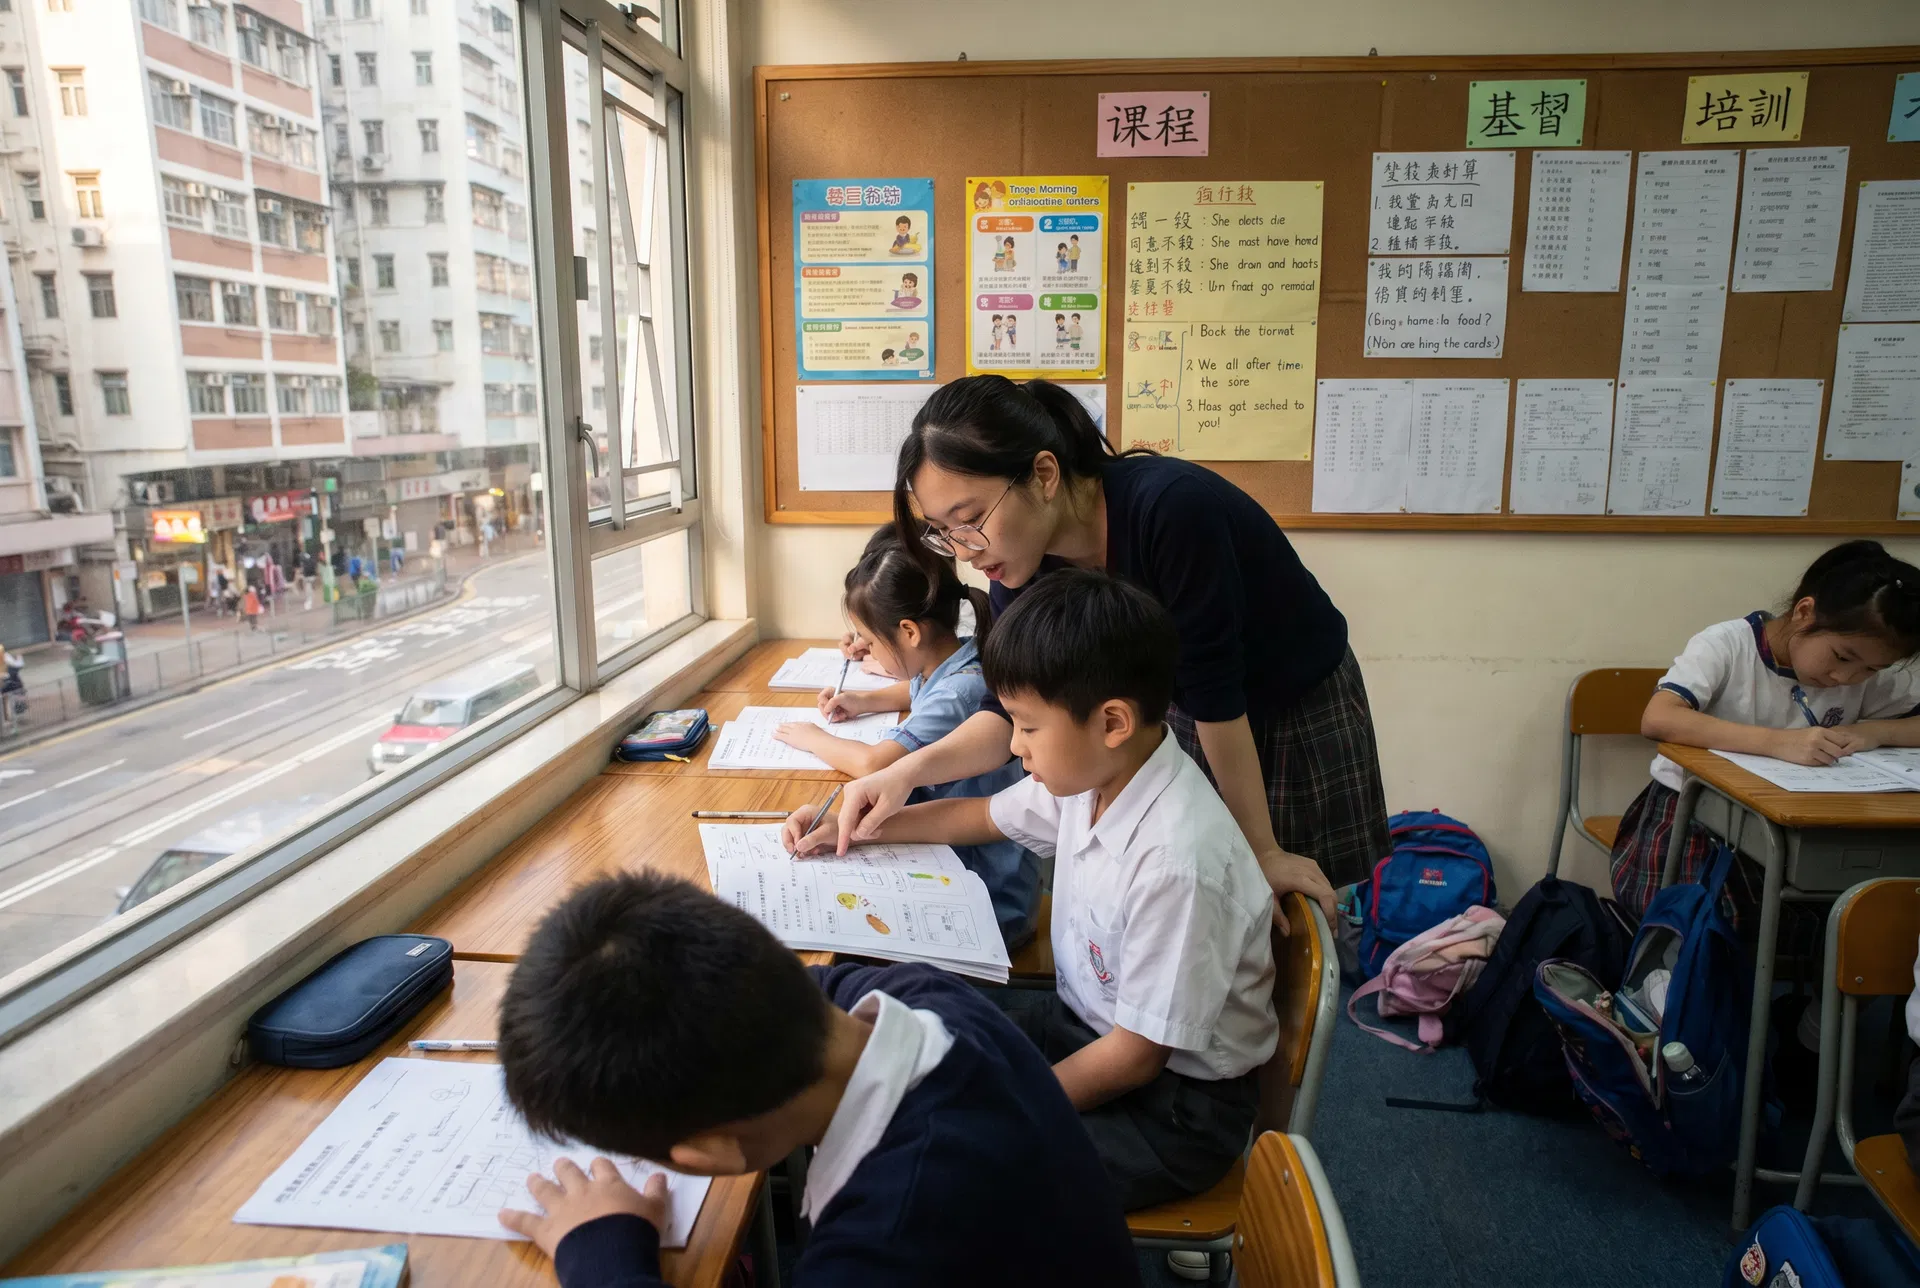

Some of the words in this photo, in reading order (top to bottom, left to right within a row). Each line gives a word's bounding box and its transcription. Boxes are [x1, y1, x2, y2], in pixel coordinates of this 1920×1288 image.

[1695, 86, 1792, 131] 培訓
[1106, 105, 1199, 148] 课程
[1044, 218, 1053, 230] 2
[1211, 213, 1230, 227] She
[1211, 235, 1230, 248] She
[1267, 236, 1289, 247] have
[1210, 257, 1229, 271] She
[1268, 258, 1286, 270] and
[1261, 283, 1274, 296] go
[1234, 324, 1250, 336] the
[1444, 337, 1460, 349] the
[1198, 358, 1217, 370] We
[1226, 357, 1239, 370] all
[1201, 376, 1219, 388] the
[1254, 399, 1288, 411] seched
[1294, 400, 1305, 411] to
[1198, 417, 1221, 433] you!
